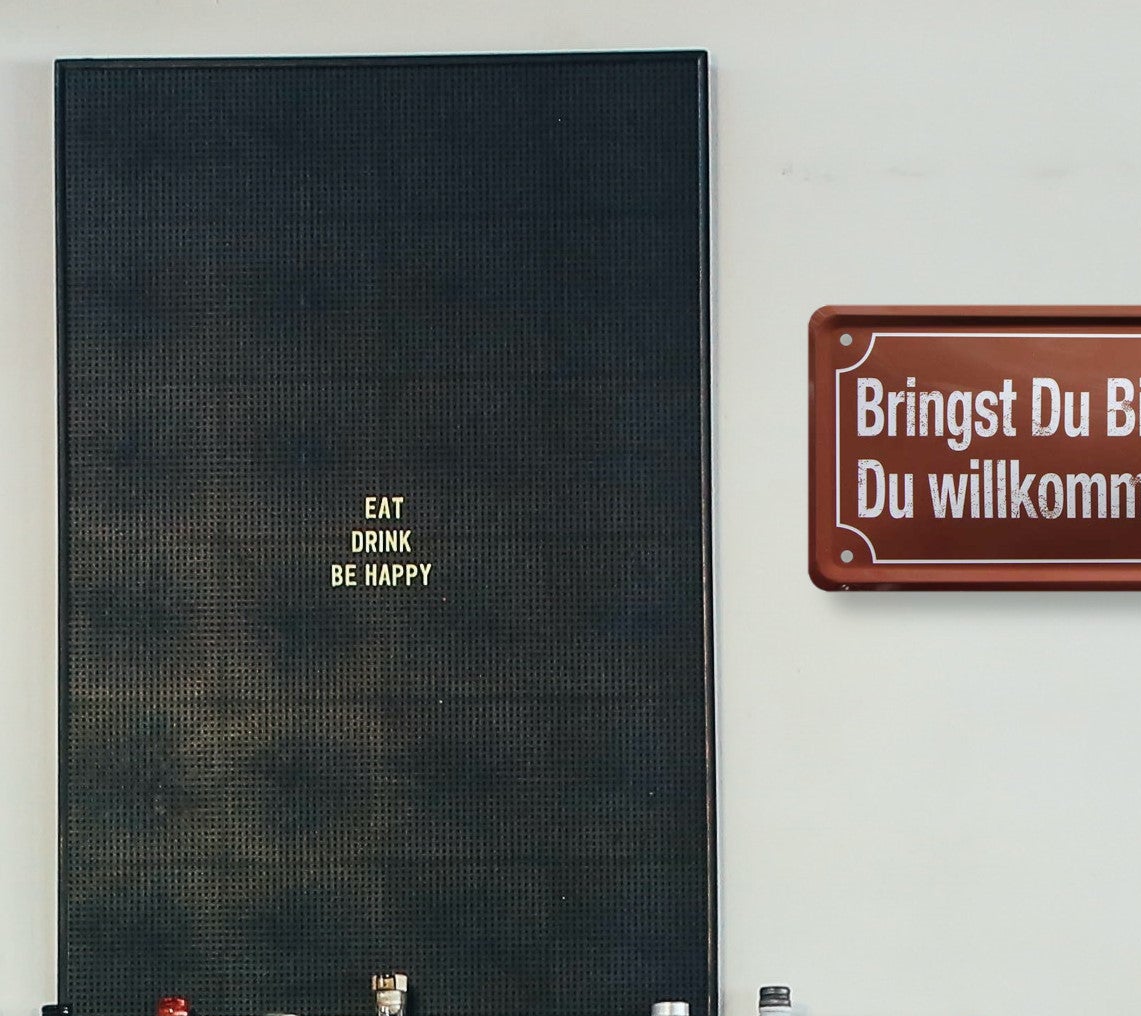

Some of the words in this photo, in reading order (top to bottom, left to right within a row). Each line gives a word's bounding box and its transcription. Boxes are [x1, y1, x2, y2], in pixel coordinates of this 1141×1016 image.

[856, 376, 1018, 452] Bringst
[1031, 376, 1091, 438] Du
[856, 458, 915, 520] Du
[364, 495, 405, 520] EAT
[350, 529, 412, 554] DRINK
[330, 563, 358, 588] BE
[364, 562, 433, 588] HAPPY
